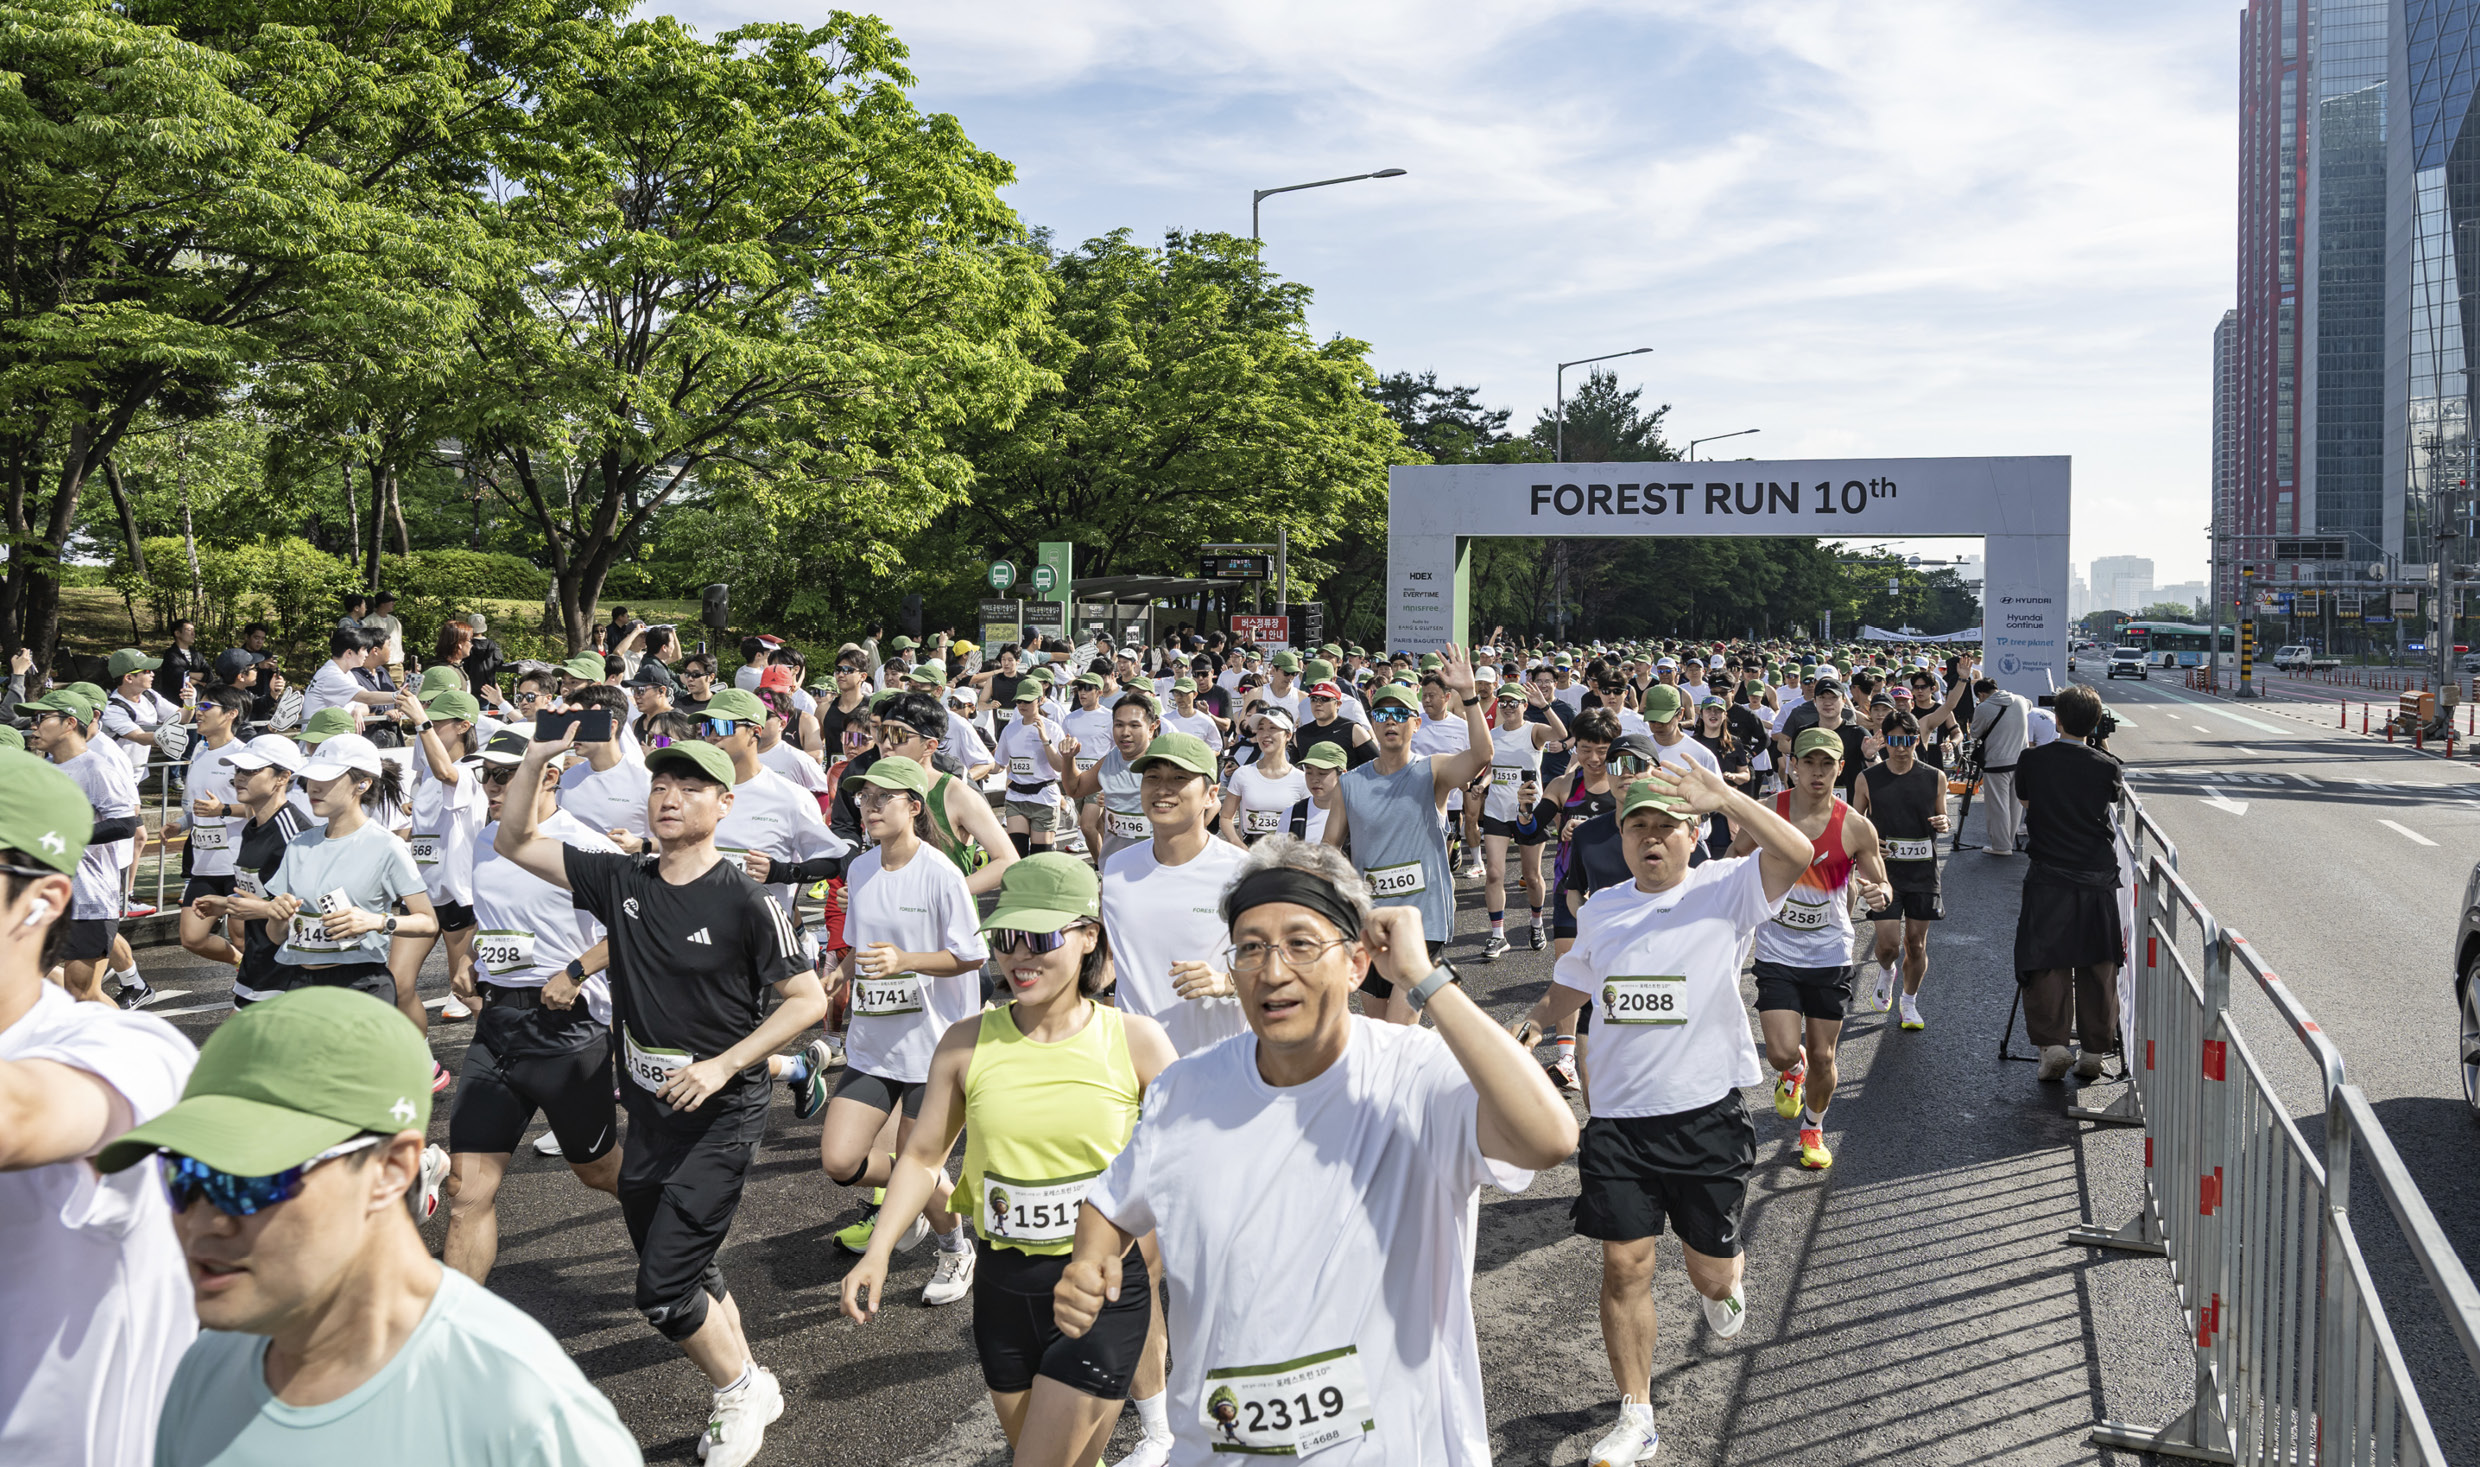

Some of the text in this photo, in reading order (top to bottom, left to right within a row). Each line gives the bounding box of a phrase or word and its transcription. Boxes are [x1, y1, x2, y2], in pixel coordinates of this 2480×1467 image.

[1530, 476, 1898, 516] FOREST RUN 10th
[1410, 572, 1432, 580] HDEX
[1241, 618, 1279, 628] 버스정류장
[2007, 614, 2043, 622] Hyundai
[1269, 630, 1283, 640] 안내
[2028, 639, 2054, 648] planet
[1497, 772, 1517, 780] 1519
[1115, 820, 1143, 832] 2196
[1258, 818, 1280, 827] 238
[1900, 847, 1926, 856] 1710
[1379, 874, 1415, 890] 2160
[1788, 910, 1821, 924] 2587
[481, 947, 520, 963] 2298
[867, 989, 908, 1005] 1741
[1619, 994, 1674, 1011] 2088
[1043, 1187, 1072, 1197] 포레스트런
[1014, 1198, 1083, 1229] 1511
[1276, 1370, 1314, 1387] 포레스트런
[1243, 1386, 1344, 1433] 2319
[1301, 1430, 1340, 1450] E-4688
